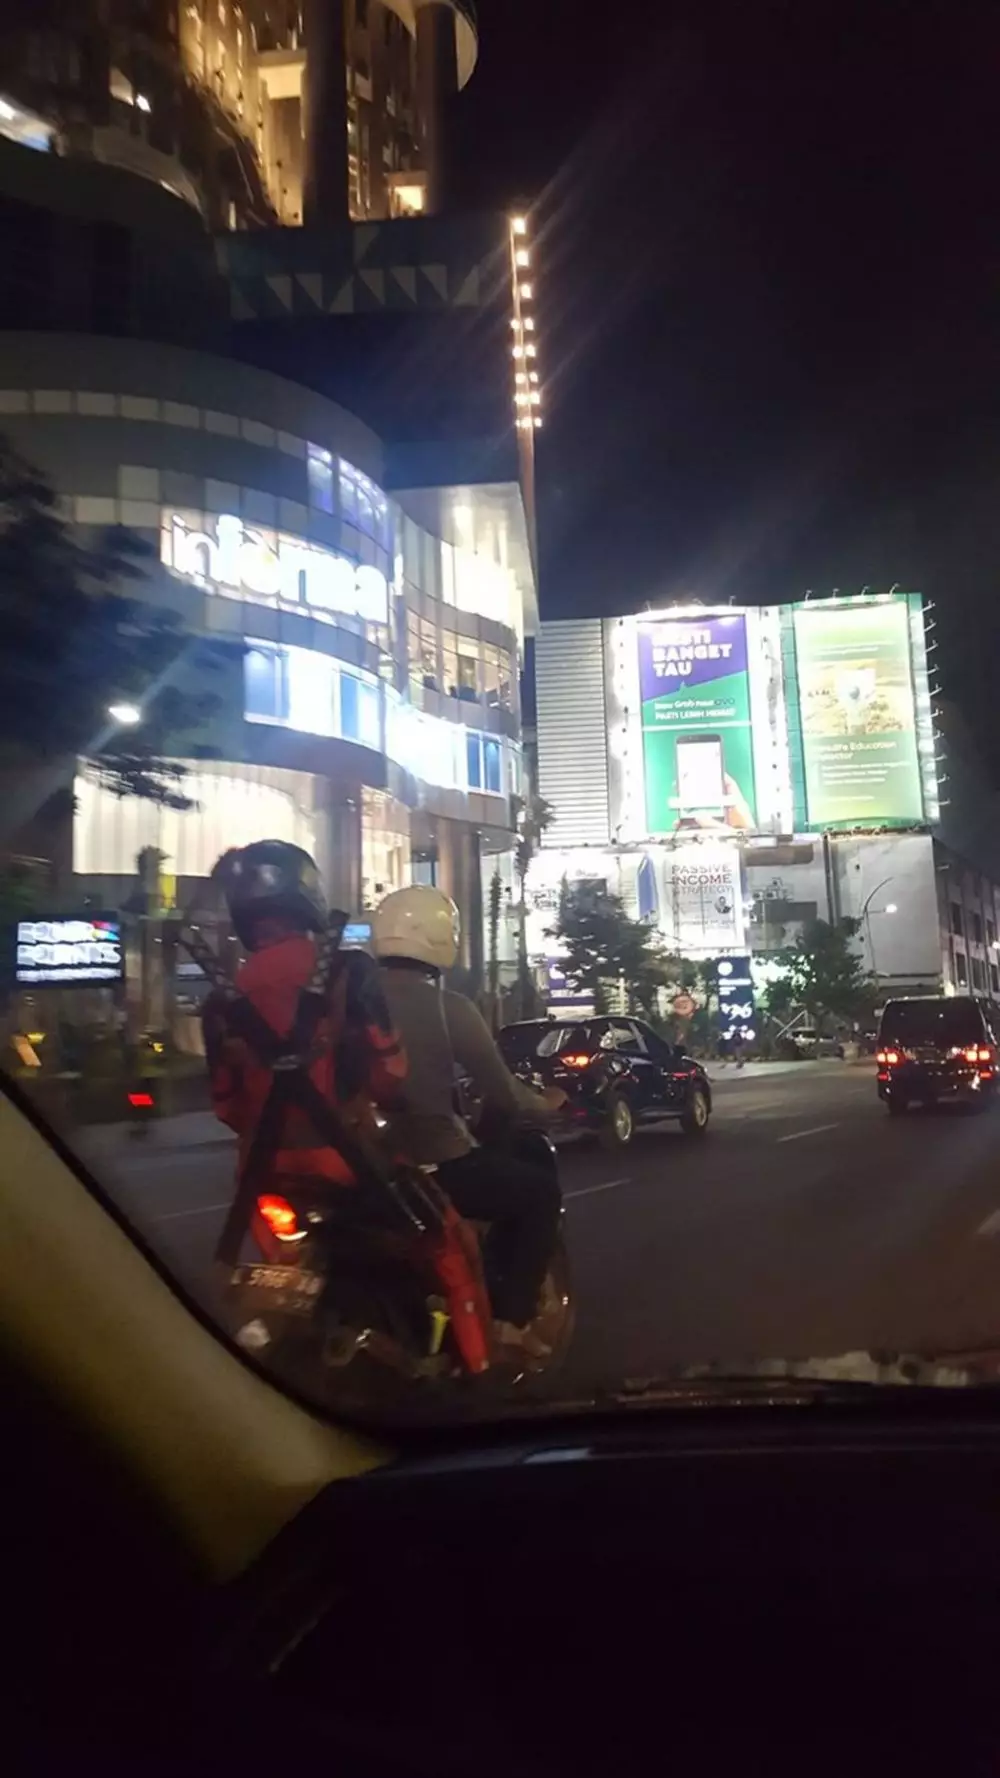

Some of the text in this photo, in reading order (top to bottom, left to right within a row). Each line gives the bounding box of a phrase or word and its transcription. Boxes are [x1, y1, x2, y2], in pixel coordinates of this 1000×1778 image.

[652, 643, 732, 661] BANGET
[652, 660, 692, 677] TAU
[671, 863, 732, 875] PASSIVE
[671, 873, 732, 886] INCOME
